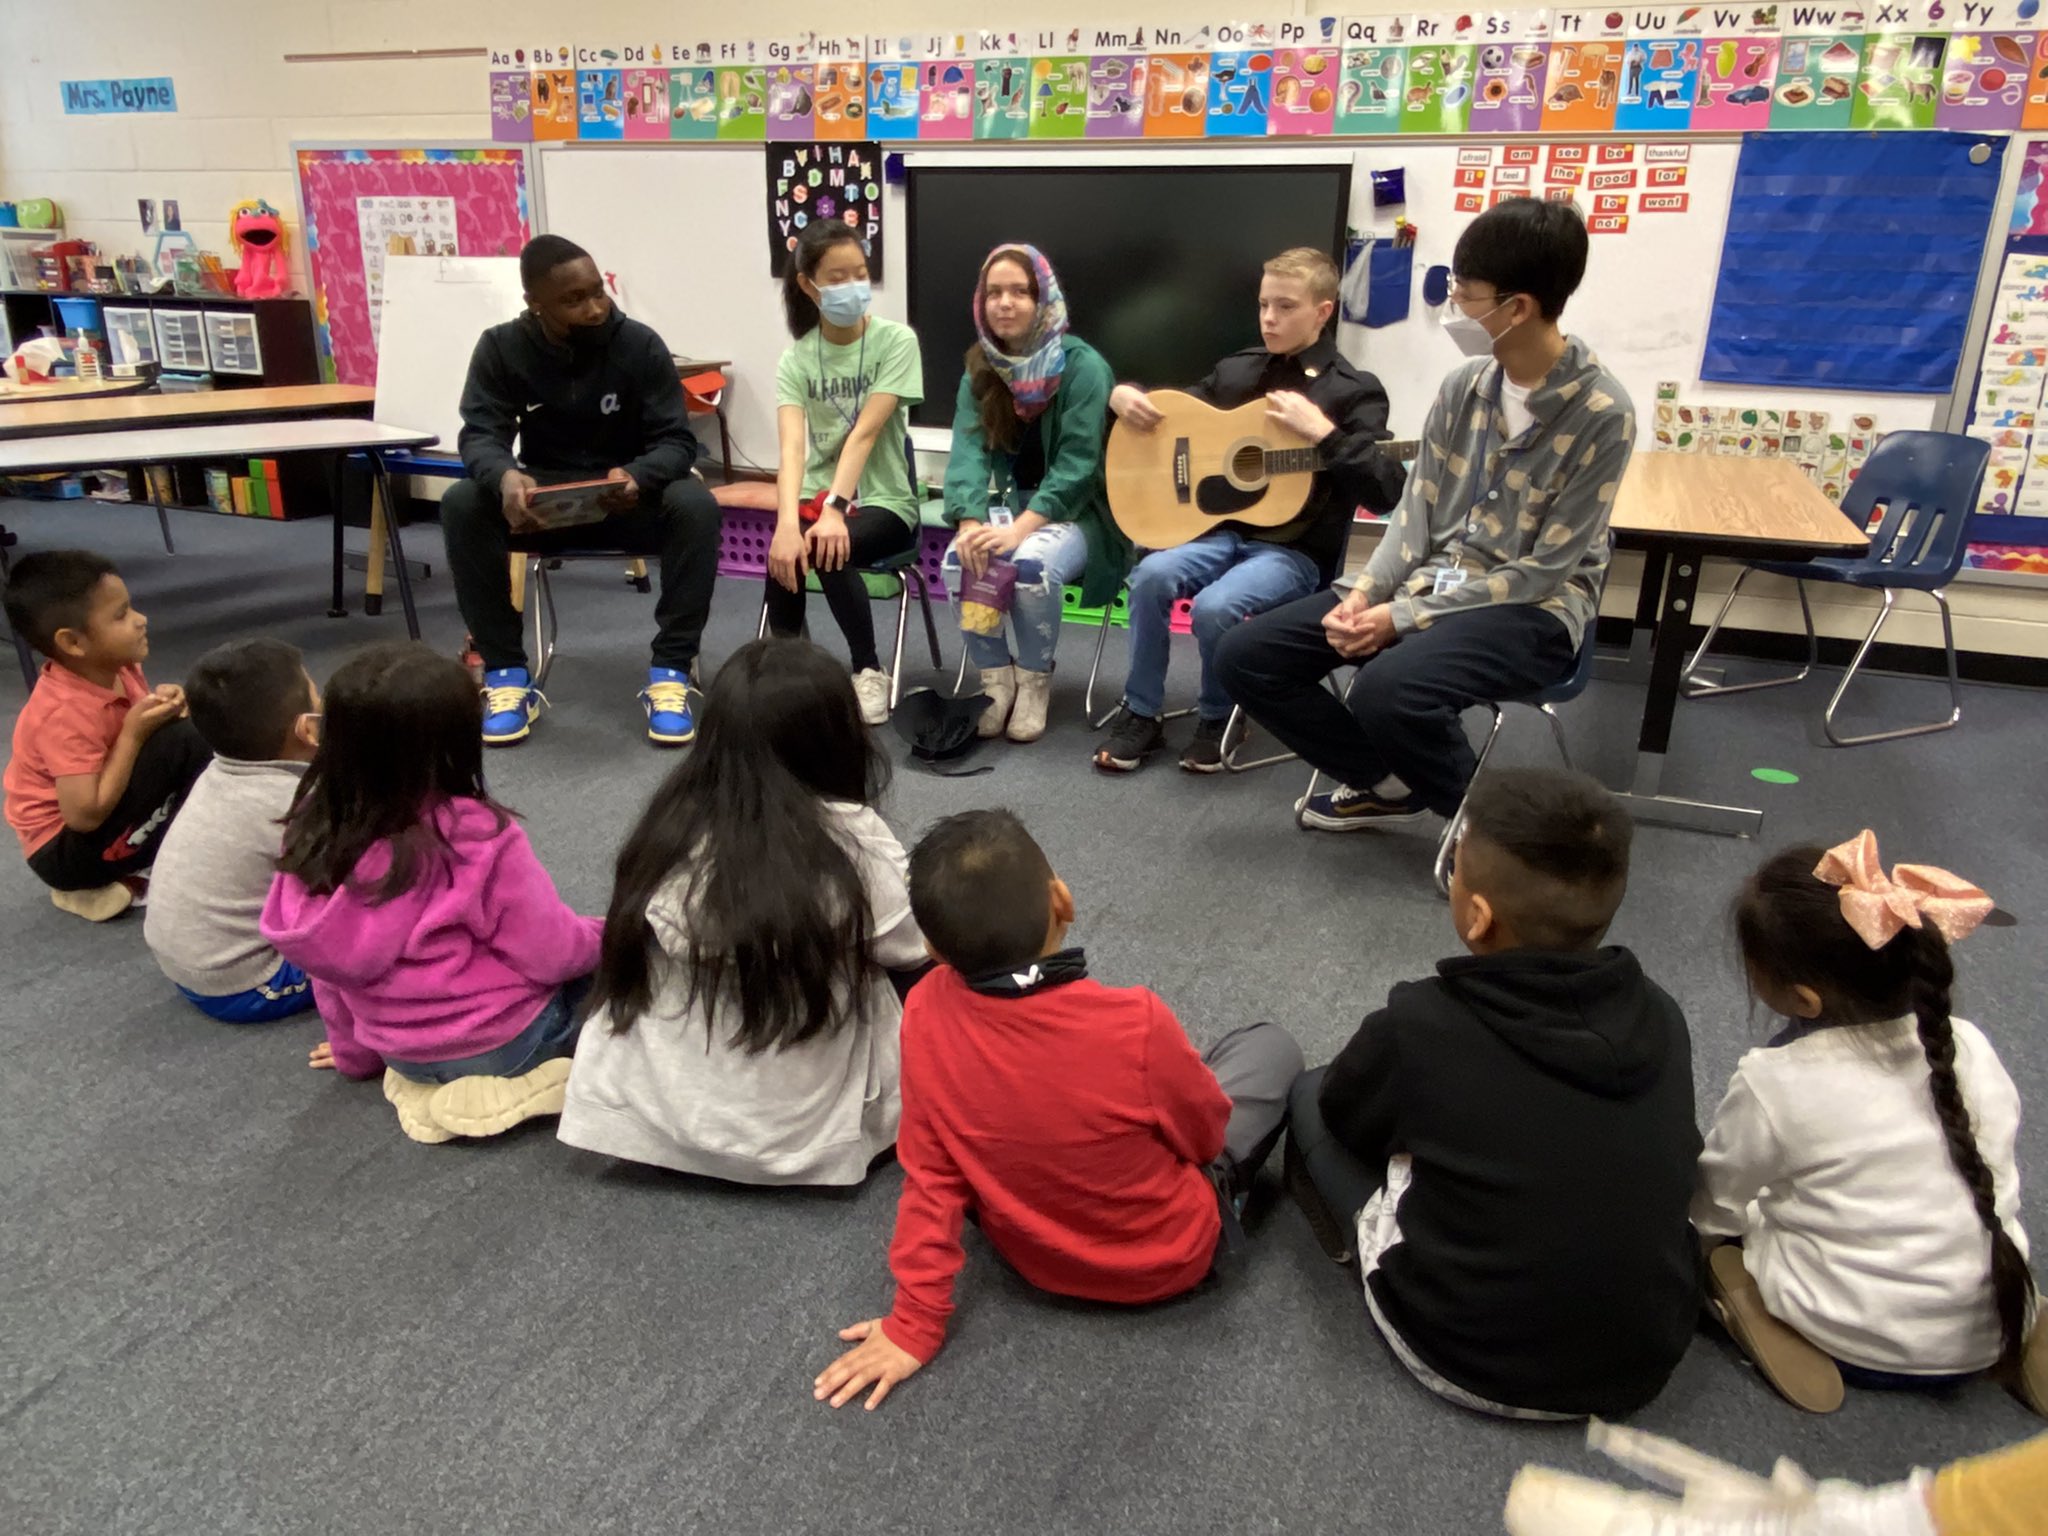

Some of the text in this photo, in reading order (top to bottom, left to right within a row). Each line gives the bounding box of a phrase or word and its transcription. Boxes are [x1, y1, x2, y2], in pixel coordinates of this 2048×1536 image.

[492, 2, 1994, 65] Aa Bb Cc Dd Ee Ff Gg Hh Ii Jj Kk Ll Mm Nn Oo Pp Qq Rr Ss Tt Uu Vv Ww Xx Yy
[66, 80, 170, 112] Mrs. Payne
[783, 159, 796, 178] B
[828, 146, 843, 164] H
[847, 149, 860, 168] A
[1512, 151, 1531, 159] am
[1558, 149, 1580, 157] see
[1607, 149, 1623, 158] be
[1648, 148, 1686, 158] thankful
[829, 168, 845, 187] M
[1502, 171, 1519, 180] feel
[1554, 168, 1574, 178] the
[1595, 173, 1629, 186] good
[1658, 171, 1676, 181] for
[1553, 191, 1567, 200] at
[1604, 198, 1617, 208] to
[1648, 197, 1680, 207] want
[775, 199, 790, 218] N
[867, 203, 880, 221] L
[779, 219, 879, 240] Y P
[1597, 219, 1618, 228] not
